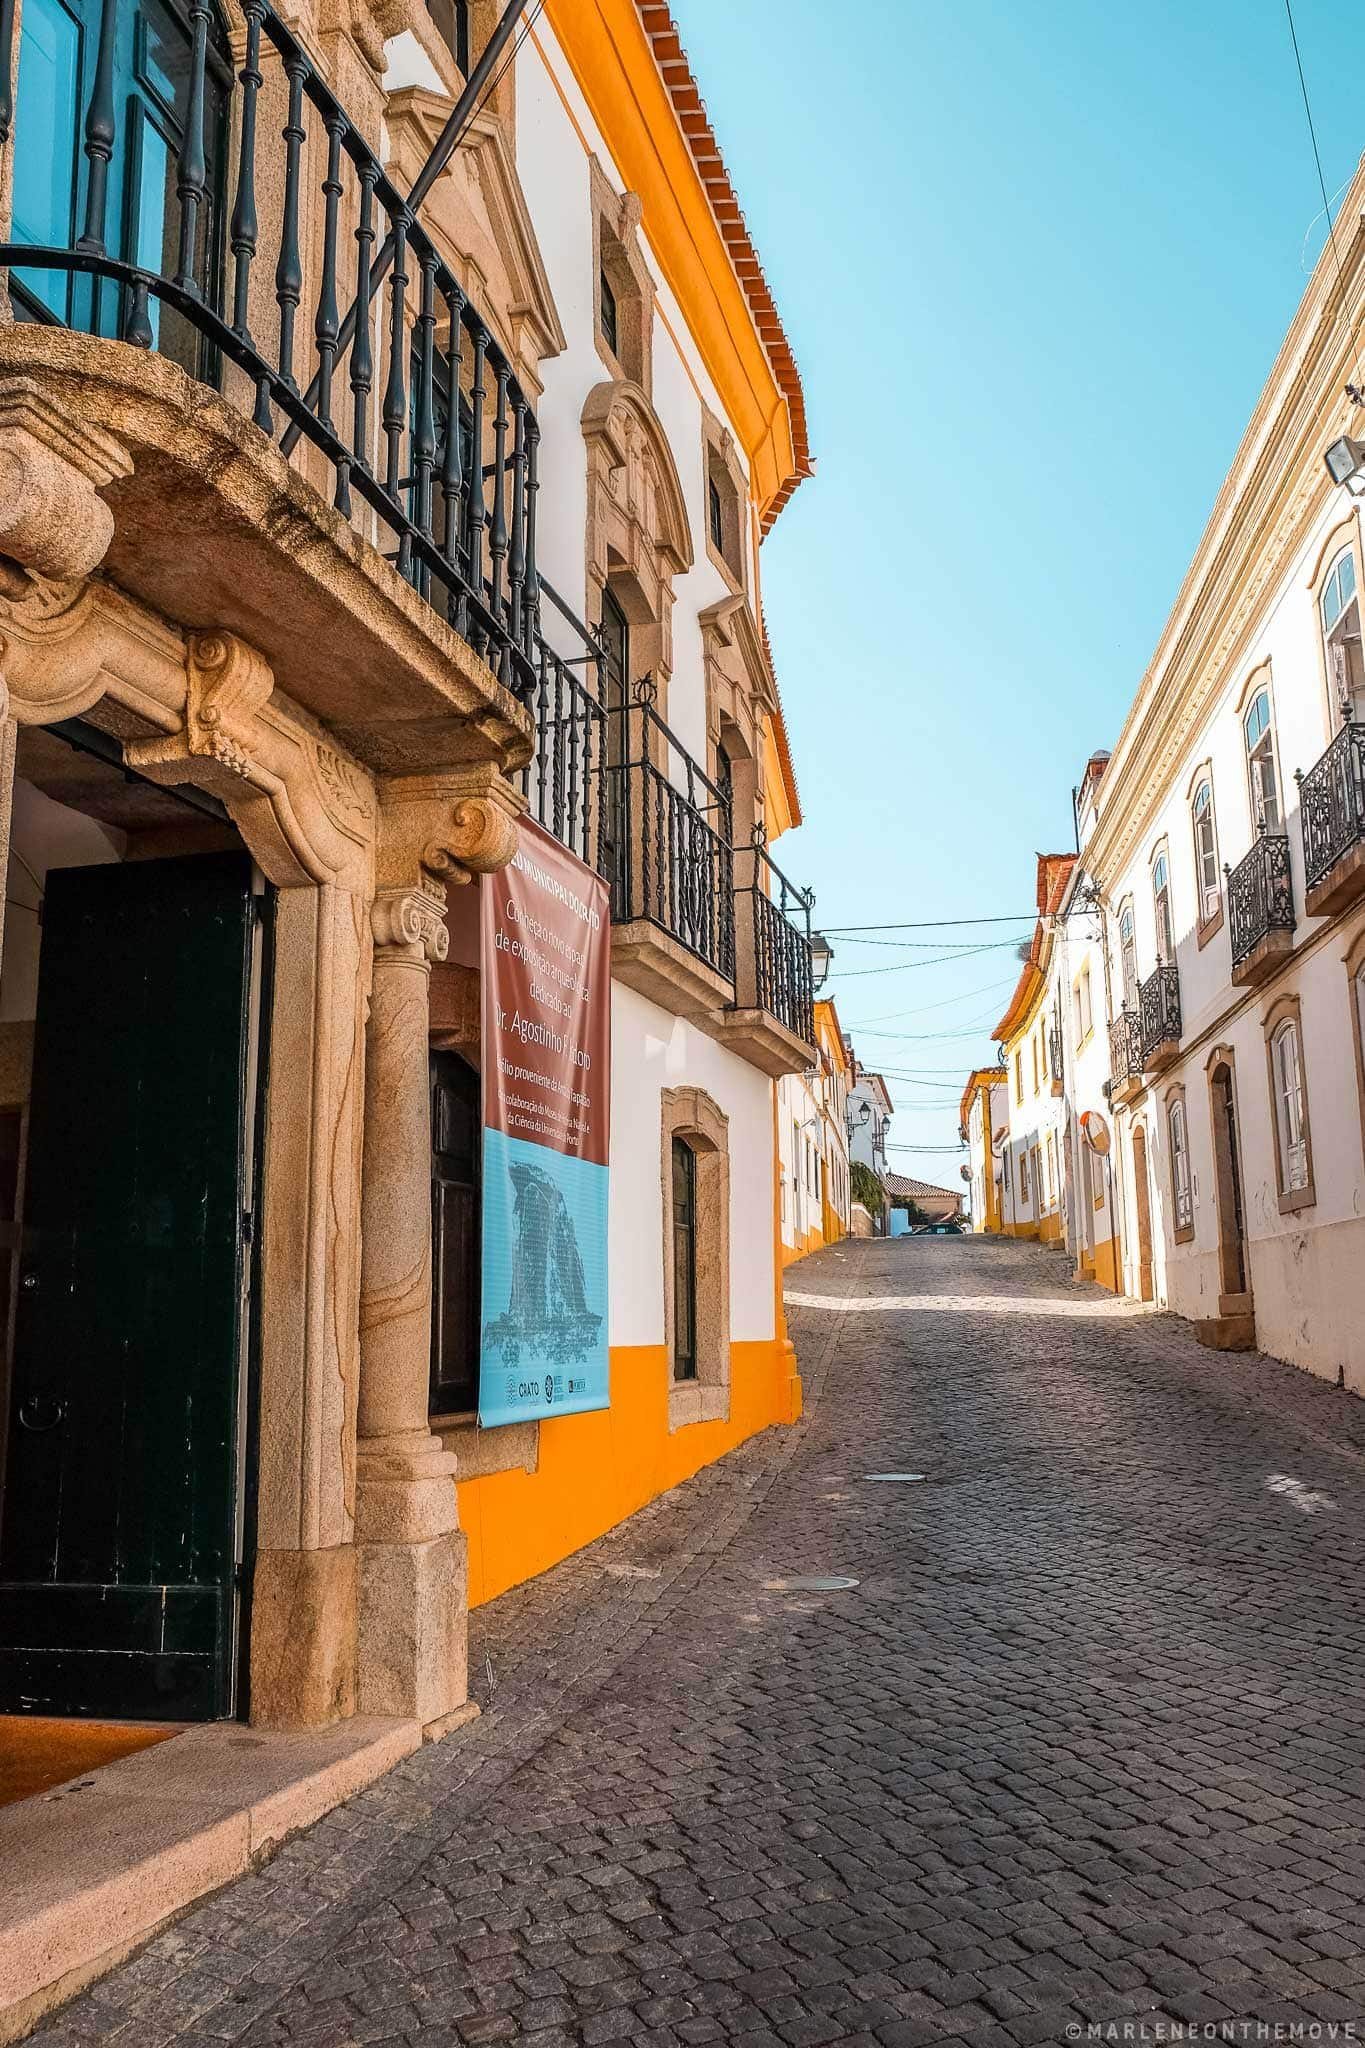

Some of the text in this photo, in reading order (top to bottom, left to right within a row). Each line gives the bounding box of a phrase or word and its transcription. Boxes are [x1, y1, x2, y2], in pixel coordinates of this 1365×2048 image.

[524, 857, 568, 906] MUNICIPAL
[495, 927, 510, 952] de
[511, 940, 551, 976] exposição
[529, 976, 573, 1018] dedicado ao
[495, 1003, 507, 1031] Dr.
[510, 1010, 562, 1053] Agostinho
[514, 1066, 551, 1089] proveniente
[551, 1078, 558, 1092] da
[506, 1093, 538, 1114] colaboração
[515, 1114, 535, 1130] Ciência
[518, 1382, 540, 1398] CRATO
